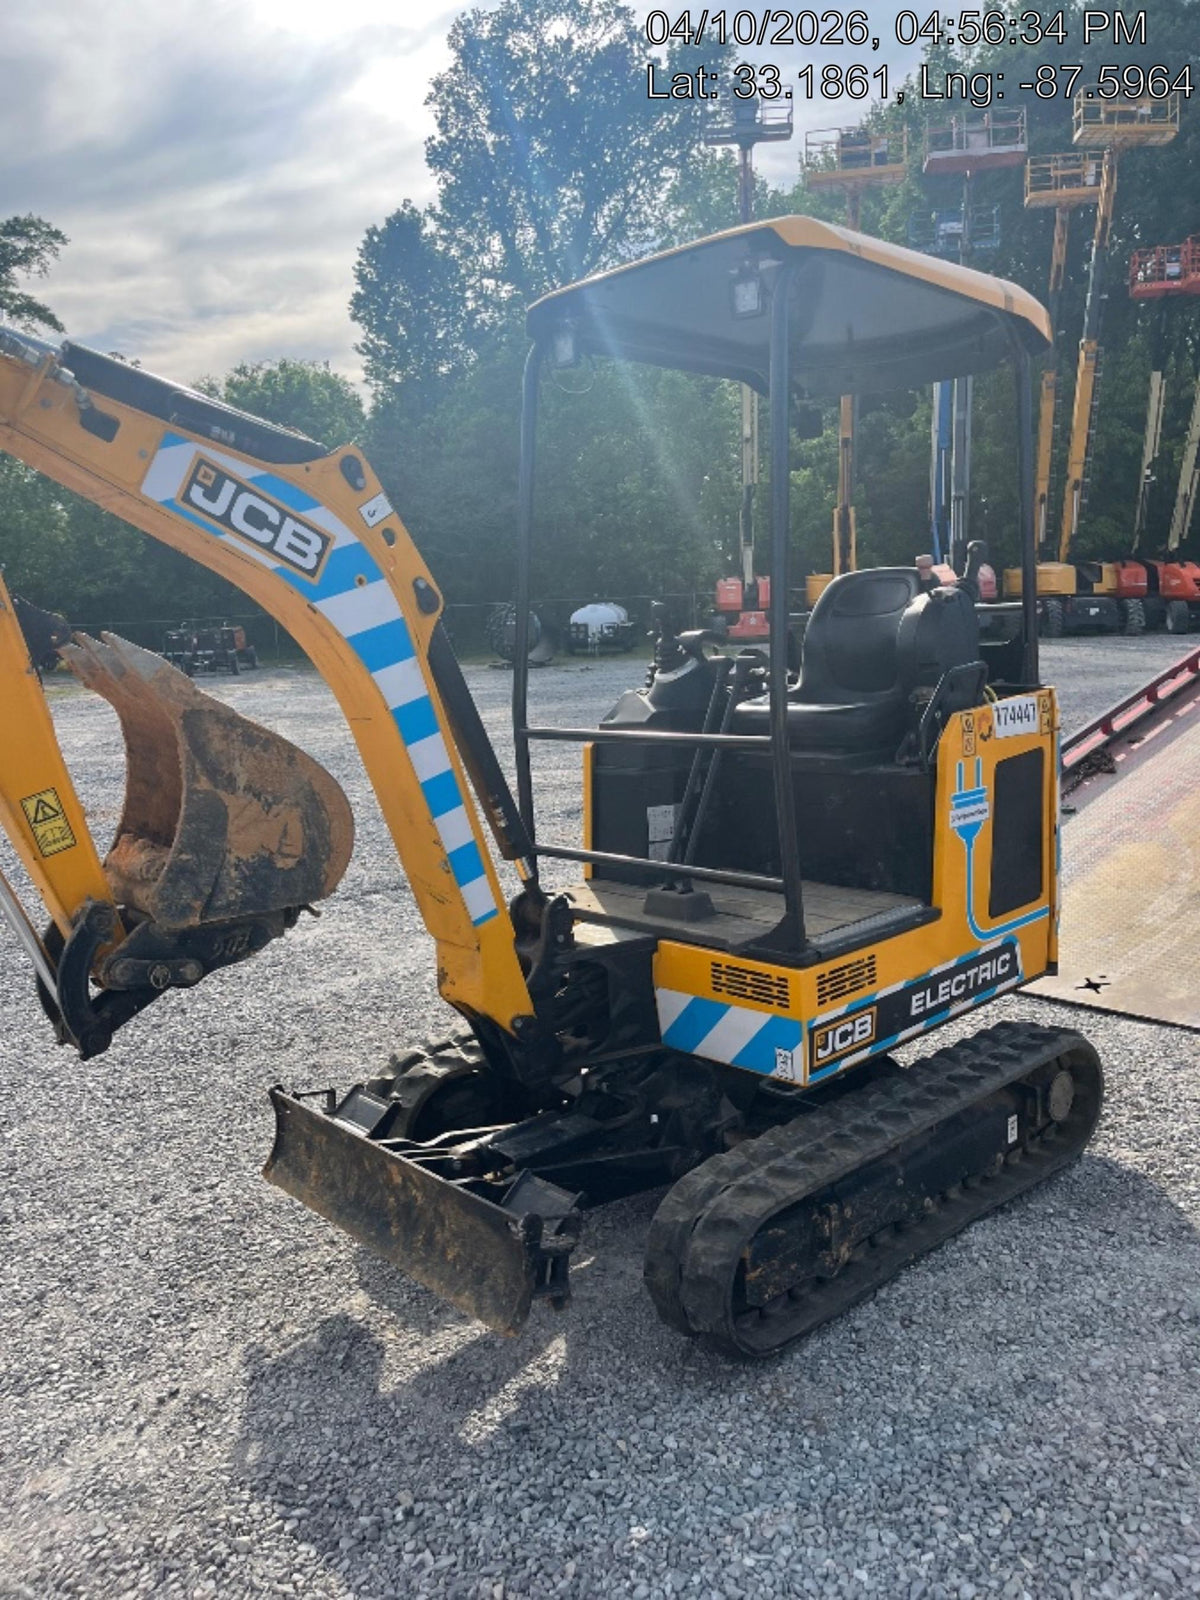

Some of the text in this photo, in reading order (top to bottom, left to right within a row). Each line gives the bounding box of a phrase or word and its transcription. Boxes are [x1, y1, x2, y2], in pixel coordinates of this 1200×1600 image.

[189, 479, 323, 570] JCB
[817, 953, 1011, 1058] JCB ELECTRIC
